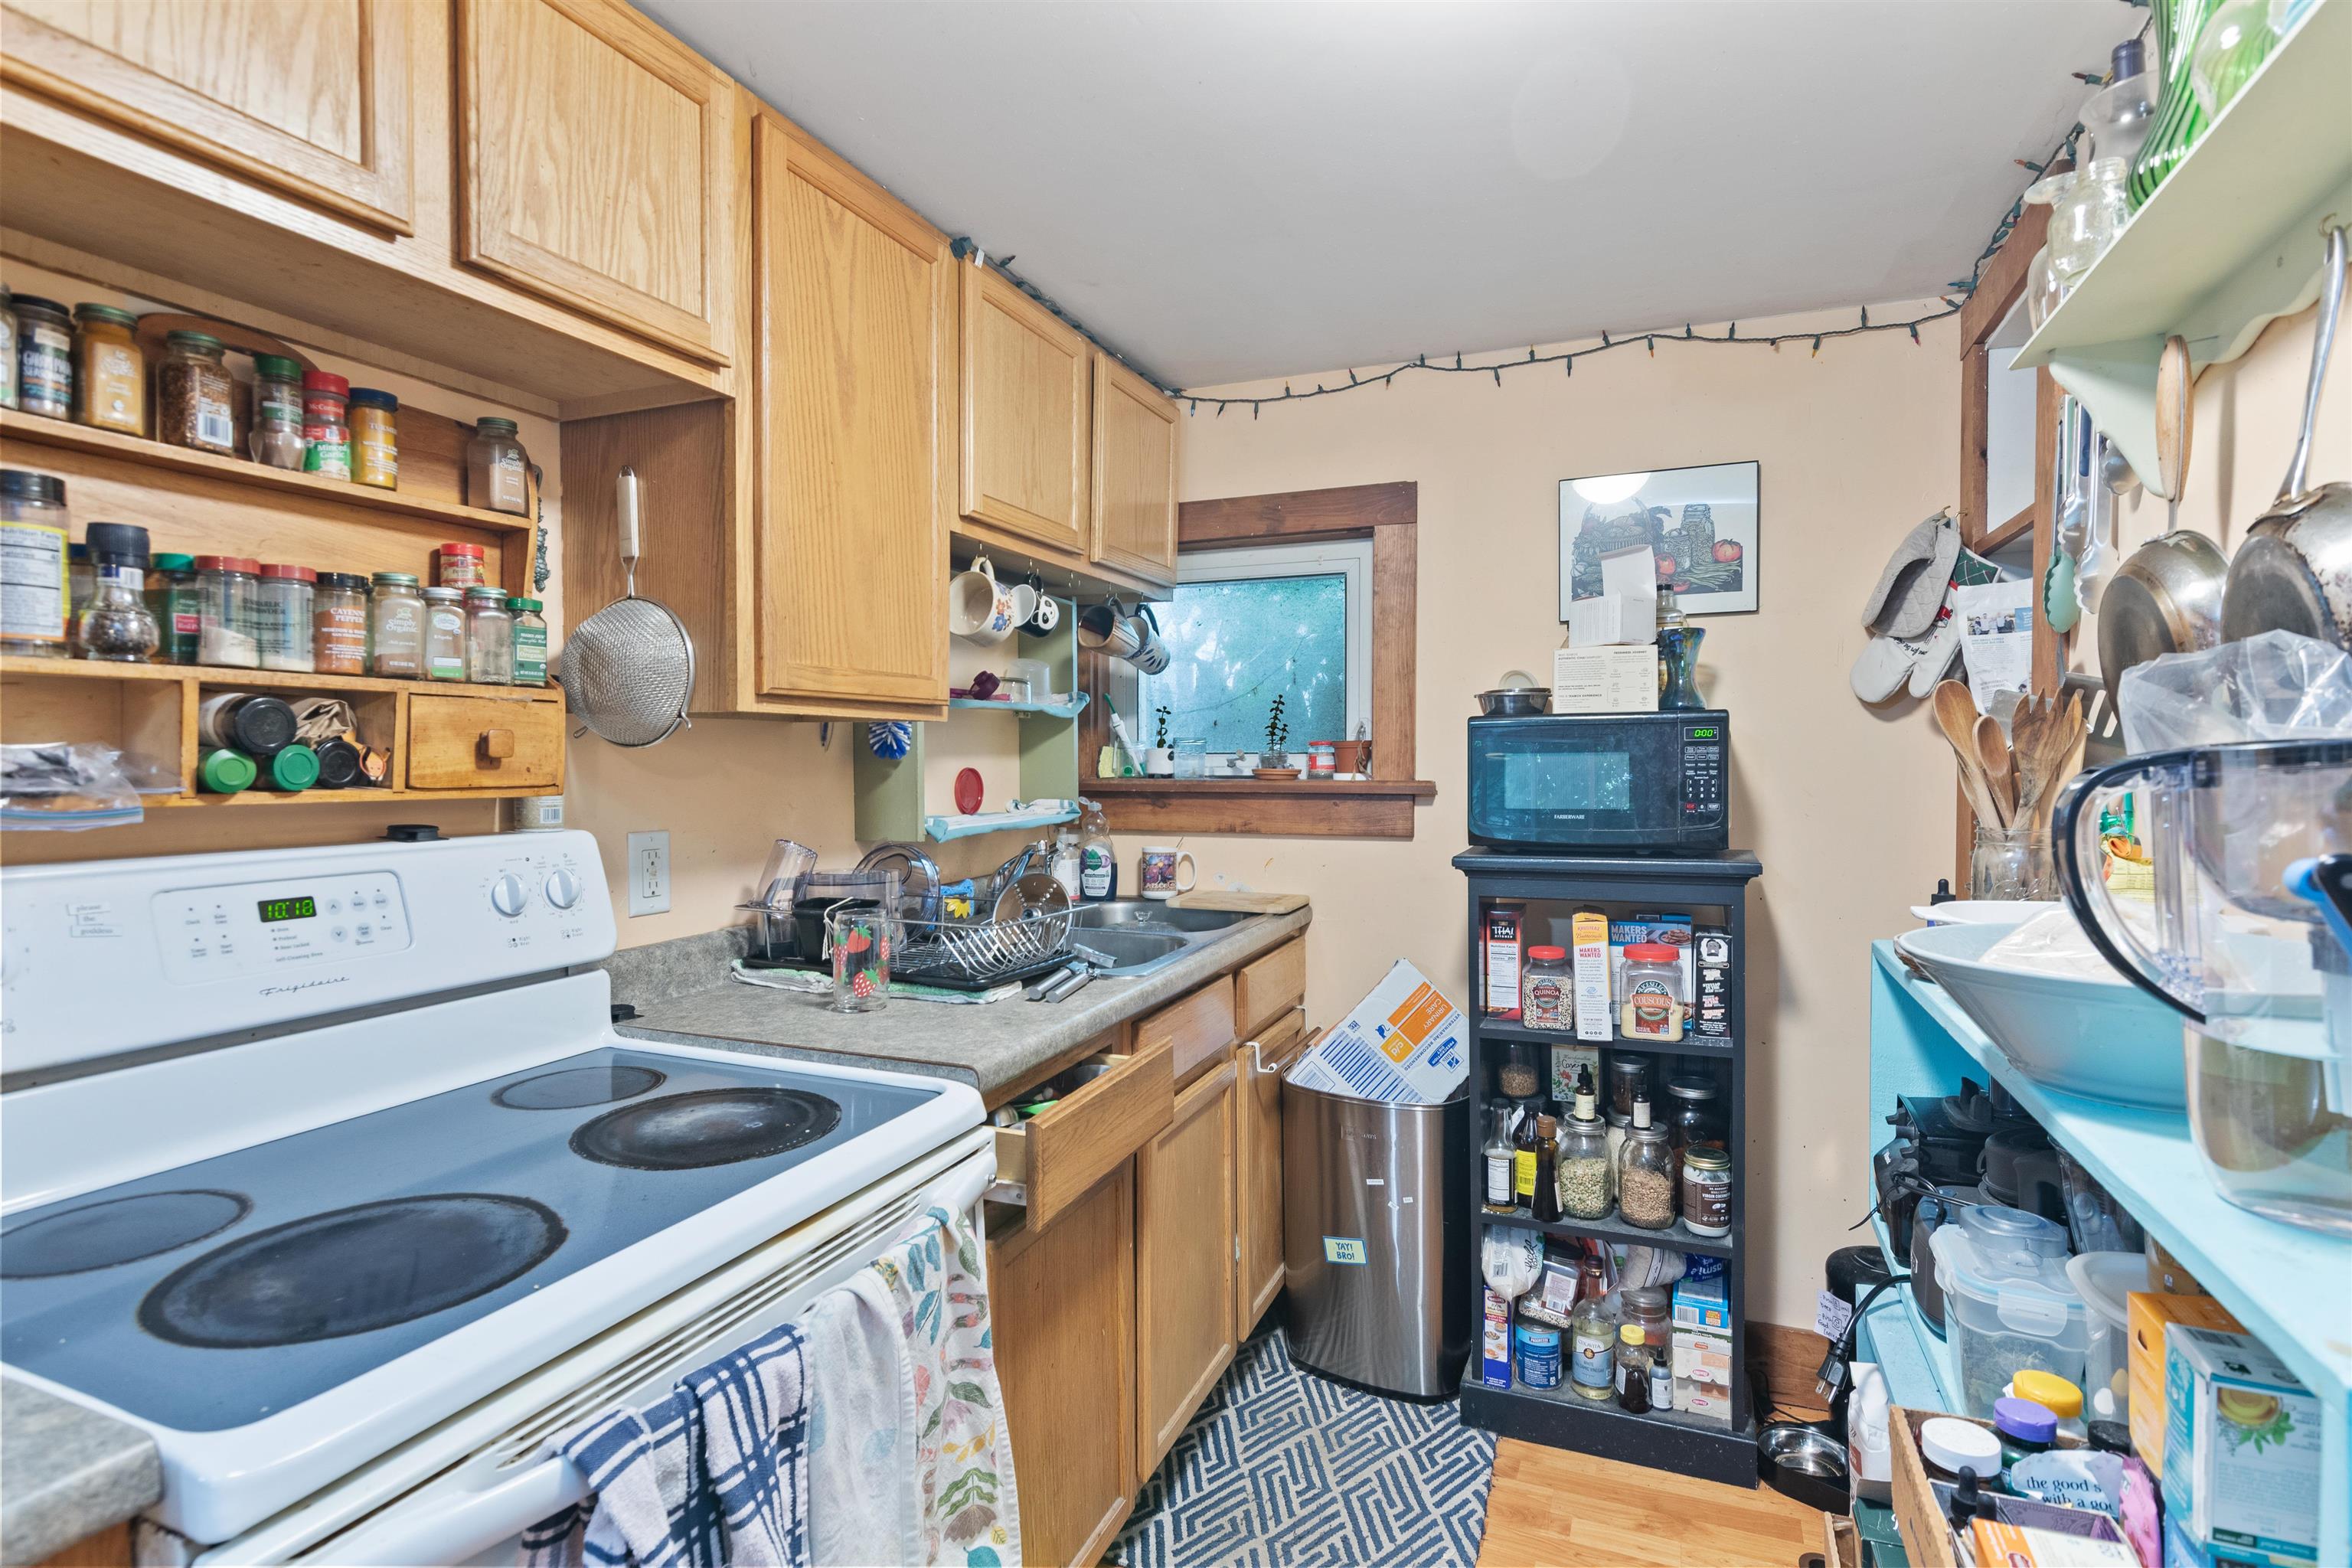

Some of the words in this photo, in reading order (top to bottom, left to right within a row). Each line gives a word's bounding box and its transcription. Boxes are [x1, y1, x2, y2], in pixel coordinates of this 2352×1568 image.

[317, 443, 347, 452] Minced
[319, 450, 345, 459] Garlic
[500, 462, 524, 472] Organic
[501, 458, 521, 468] Simply
[388, 618, 416, 627] Simply
[385, 623, 418, 633] Organic
[519, 651, 544, 659] Oregano
[1694, 729, 1713, 737] 0:00
[266, 898, 314, 920] 10:18
[1491, 926, 1514, 936] THAI
[1611, 924, 1648, 934] MAKERS
[1611, 933, 1648, 943] WANTED
[259, 976, 350, 996] Frigidaire
[1634, 995, 1671, 1007] COUSCOUS
[1426, 998, 1442, 1016] CARE
[1423, 1003, 1449, 1031] URINARY
[1432, 1012, 1462, 1042] VETERINARIAN
[1403, 1040, 1434, 1072] RECOMMENDED
[1432, 1040, 1455, 1065] PRESCRIPTION
[1335, 1242, 1354, 1252] YAY!
[1336, 1251, 1355, 1261] BRO!
[1577, 1338, 1601, 1349] COLAVITA
[2027, 1476, 2048, 1489] the
[2052, 1479, 2089, 1492] good
[2042, 1493, 2072, 1504] with
[2077, 1498, 2086, 1508] a
